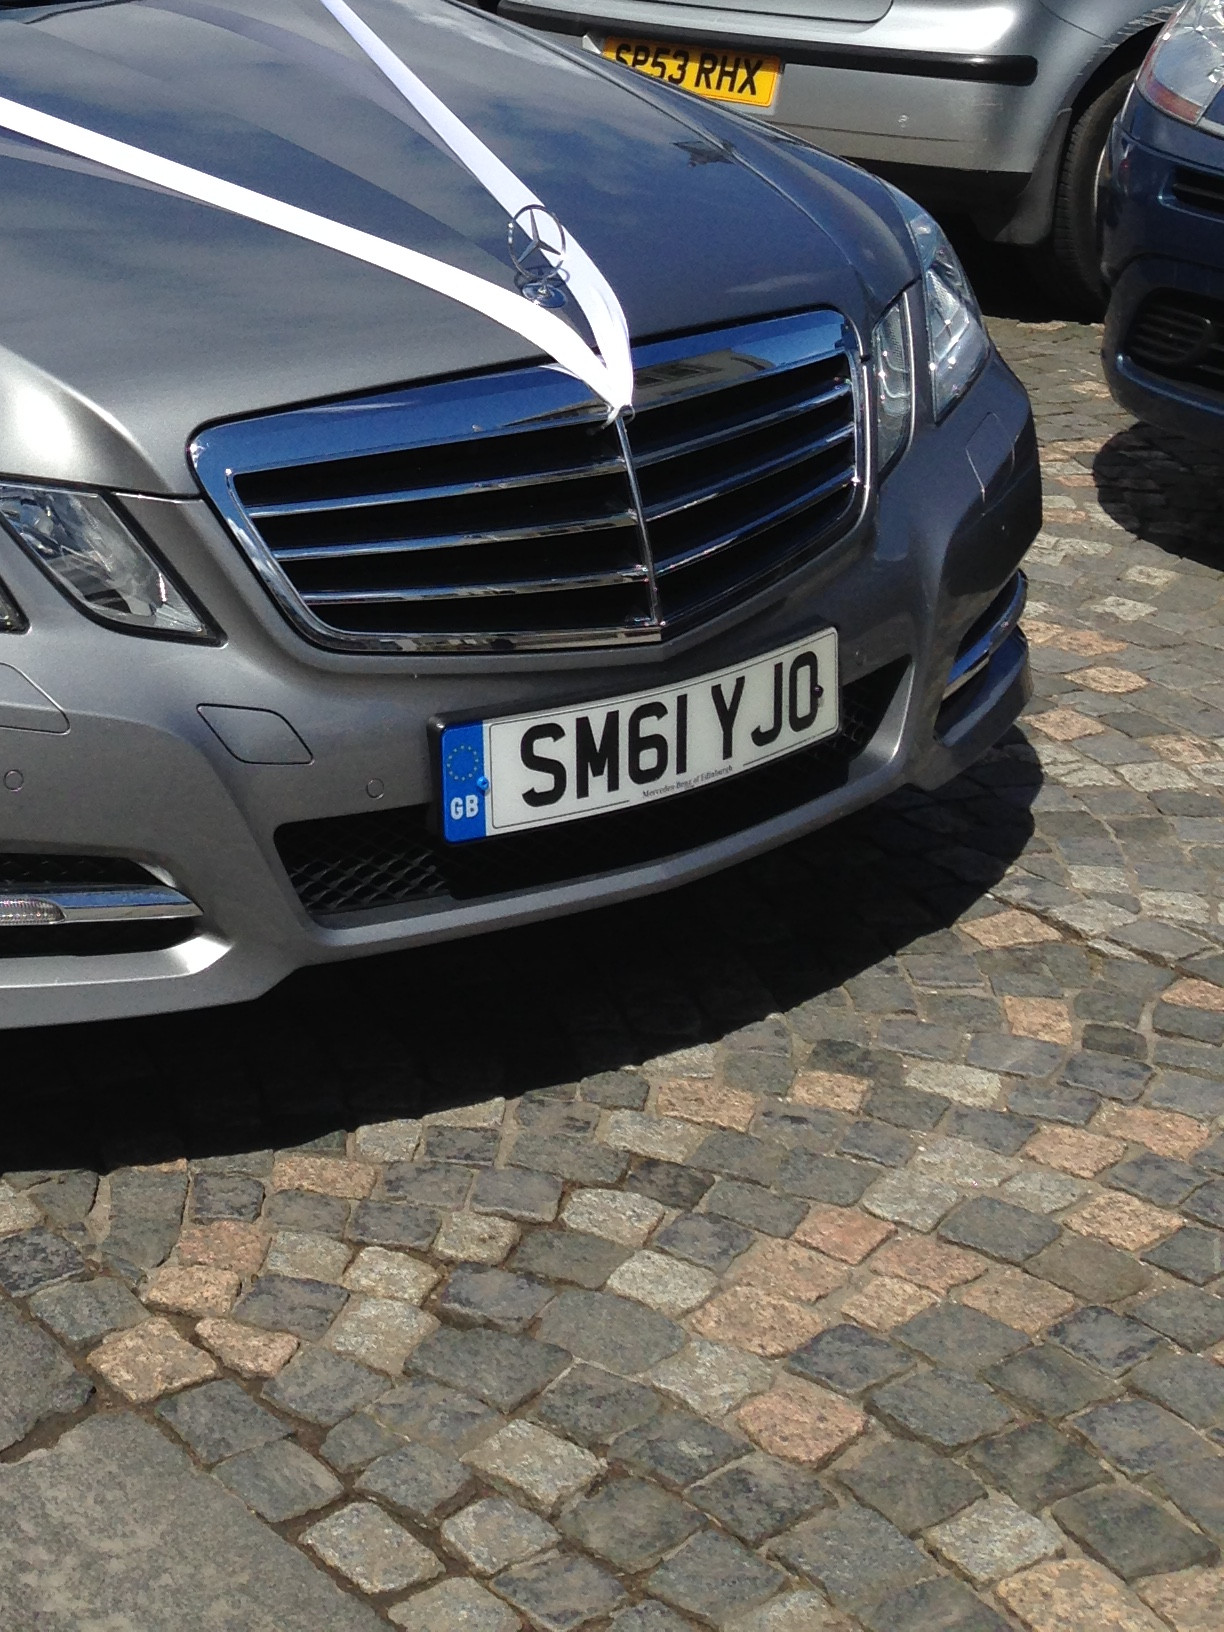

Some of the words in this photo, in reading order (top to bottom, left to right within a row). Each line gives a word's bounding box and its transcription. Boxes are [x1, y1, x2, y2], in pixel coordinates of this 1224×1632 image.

[615, 43, 690, 86] SP53
[694, 52, 763, 96] RHX
[519, 694, 689, 809] SM61
[710, 650, 819, 761] YJO
[449, 793, 479, 821] GB
